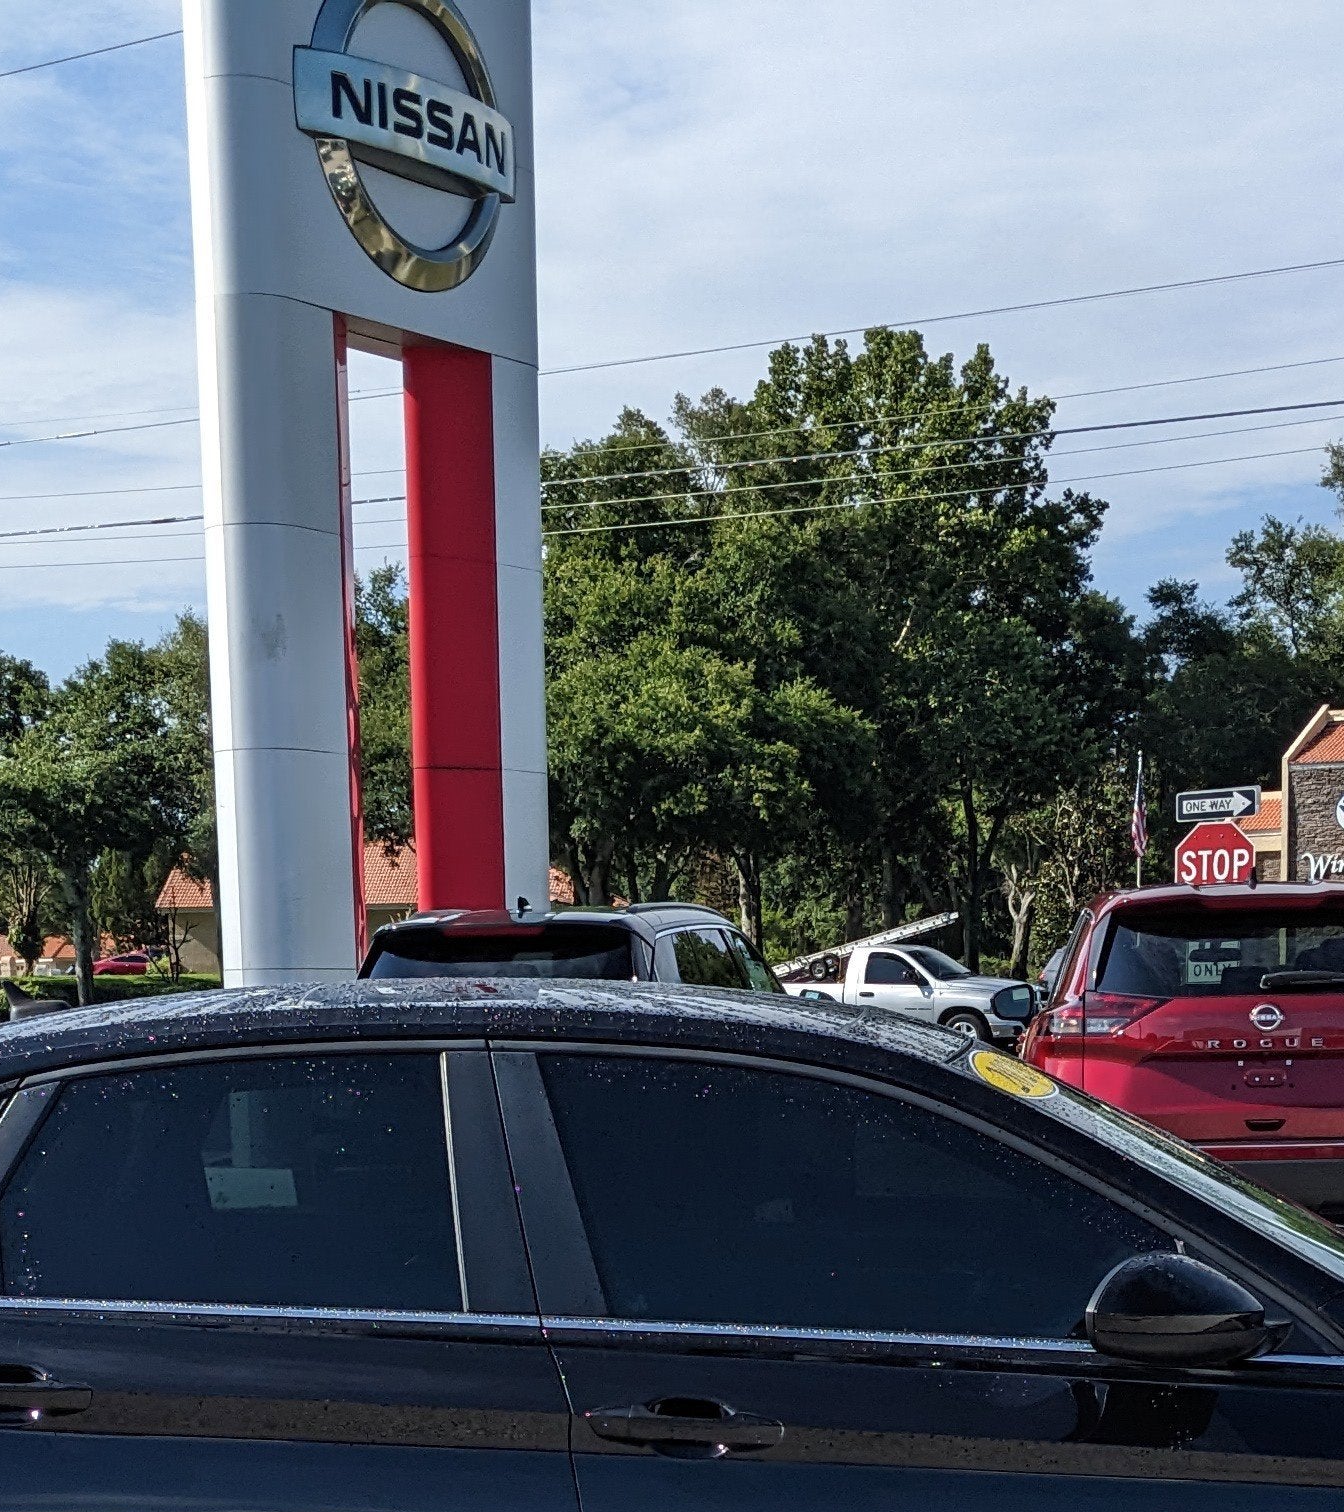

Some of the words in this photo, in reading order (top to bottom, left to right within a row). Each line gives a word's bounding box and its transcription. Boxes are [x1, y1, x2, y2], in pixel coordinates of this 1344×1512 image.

[330, 70, 506, 176] NISSAN
[1186, 800, 1206, 813] ONE
[1208, 798, 1232, 811] WAY
[1180, 848, 1250, 882] STOP
[1207, 1037, 1324, 1049] ROGUE
